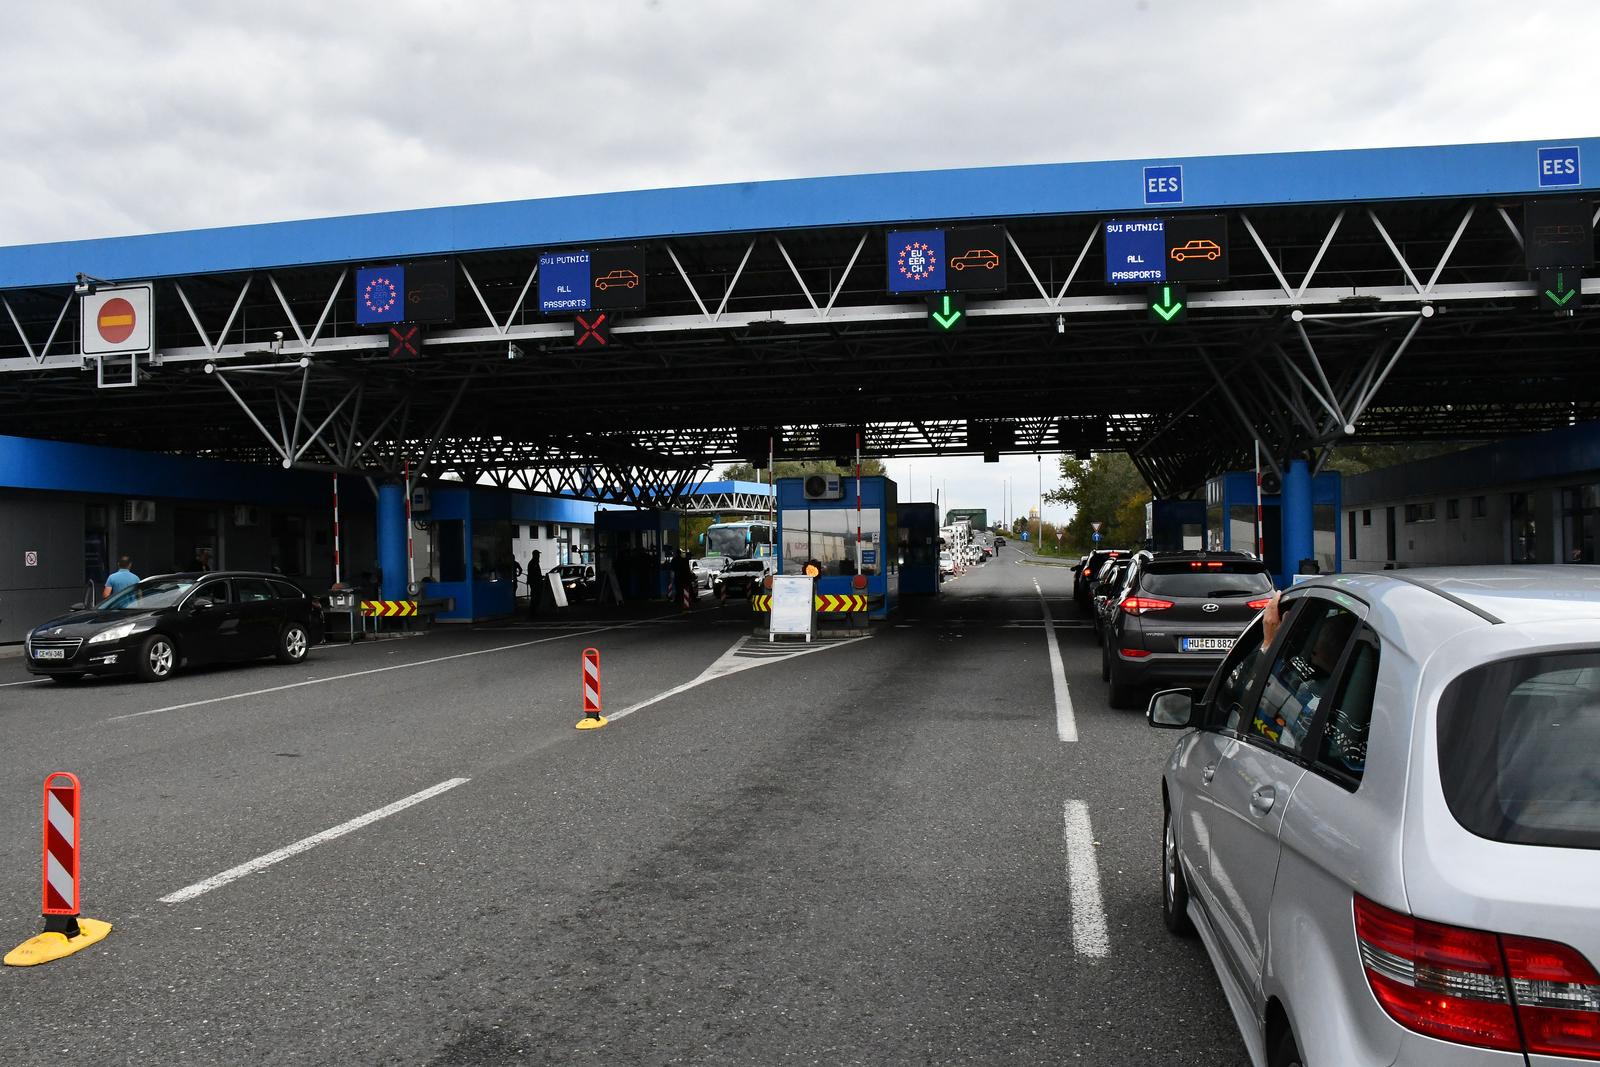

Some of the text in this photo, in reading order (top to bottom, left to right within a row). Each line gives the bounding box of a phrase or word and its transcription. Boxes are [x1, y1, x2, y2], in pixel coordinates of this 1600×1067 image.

[1543, 158, 1575, 175] EES
[1148, 177, 1178, 193] EES
[1107, 222, 1163, 233] SVI PUTNICI
[556, 254, 589, 264] PUTNICI
[908, 257, 925, 265] EEA
[1127, 255, 1144, 263] ALL
[1112, 270, 1161, 280] PASSPORTS
[556, 285, 572, 293] ALL
[543, 299, 587, 308] PASSPORTS
[1188, 639, 1199, 648] HU
[1205, 639, 1216, 648] ED
